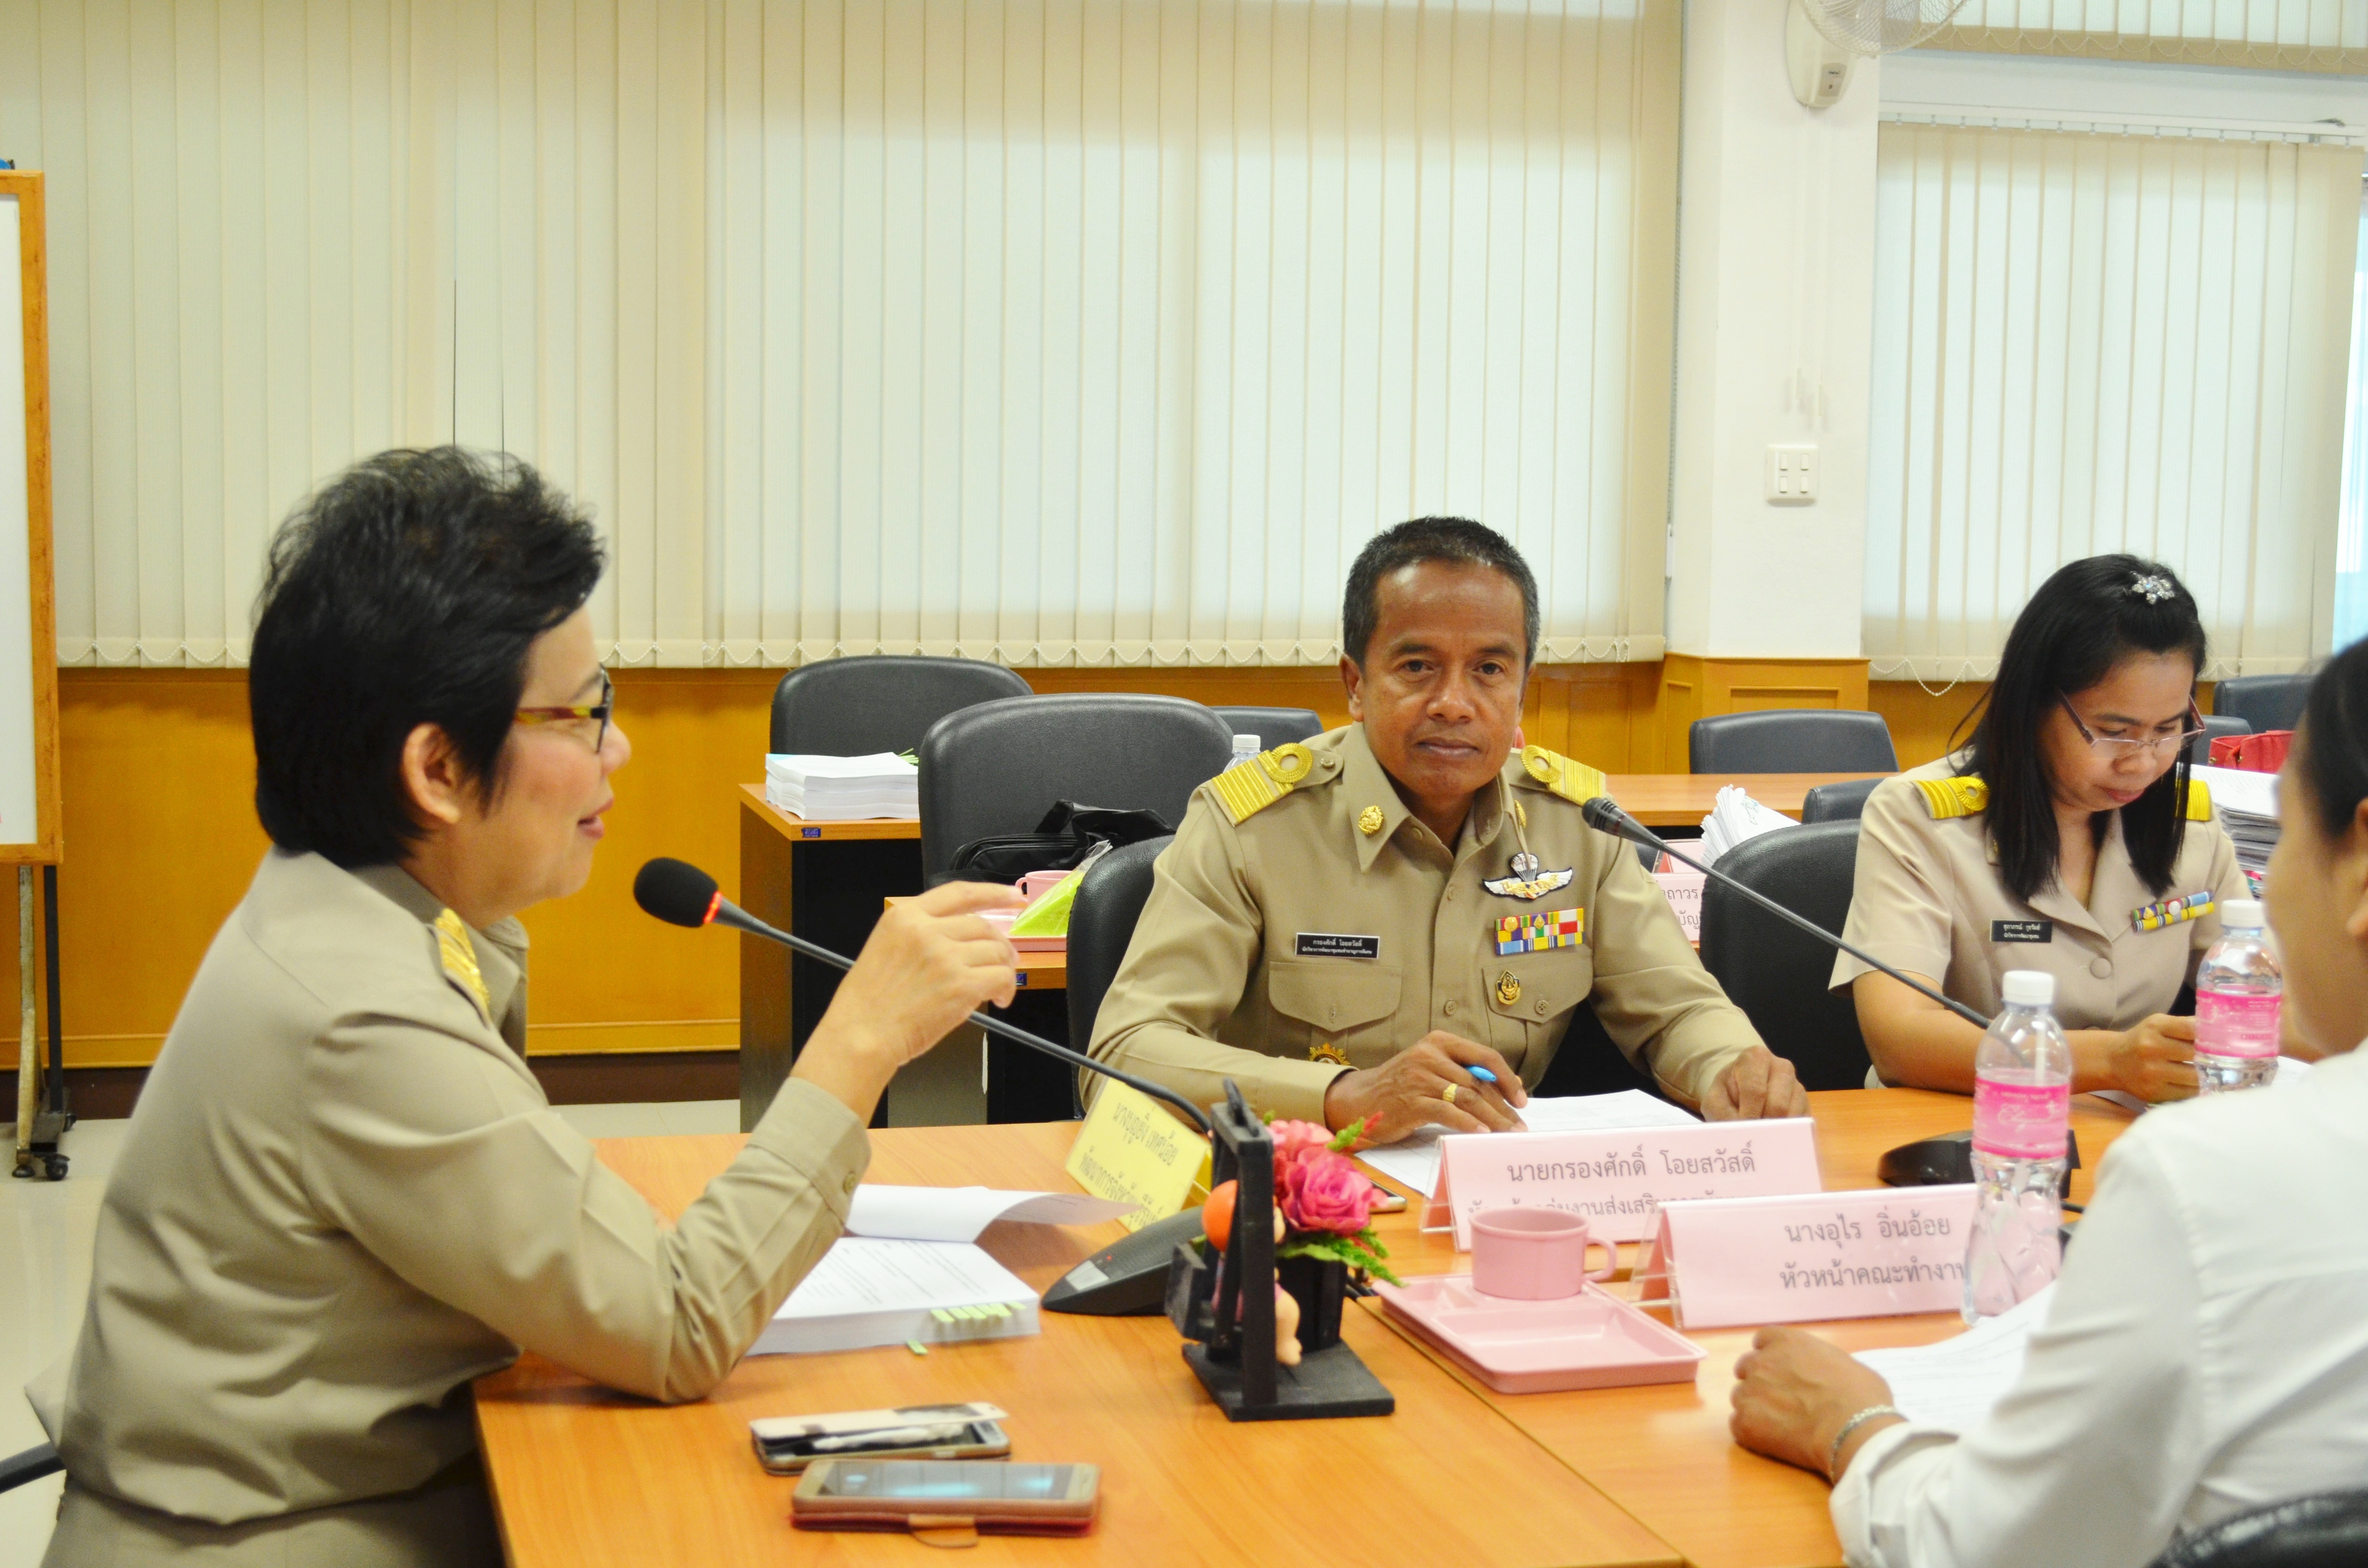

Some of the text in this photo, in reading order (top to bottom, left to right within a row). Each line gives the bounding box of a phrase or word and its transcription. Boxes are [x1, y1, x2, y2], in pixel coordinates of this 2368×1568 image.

[1507, 1139, 1755, 1182] นายกรองศักดิ์ โอยสวัสดิ์
[1785, 1213, 1862, 1249] นางอุไร
